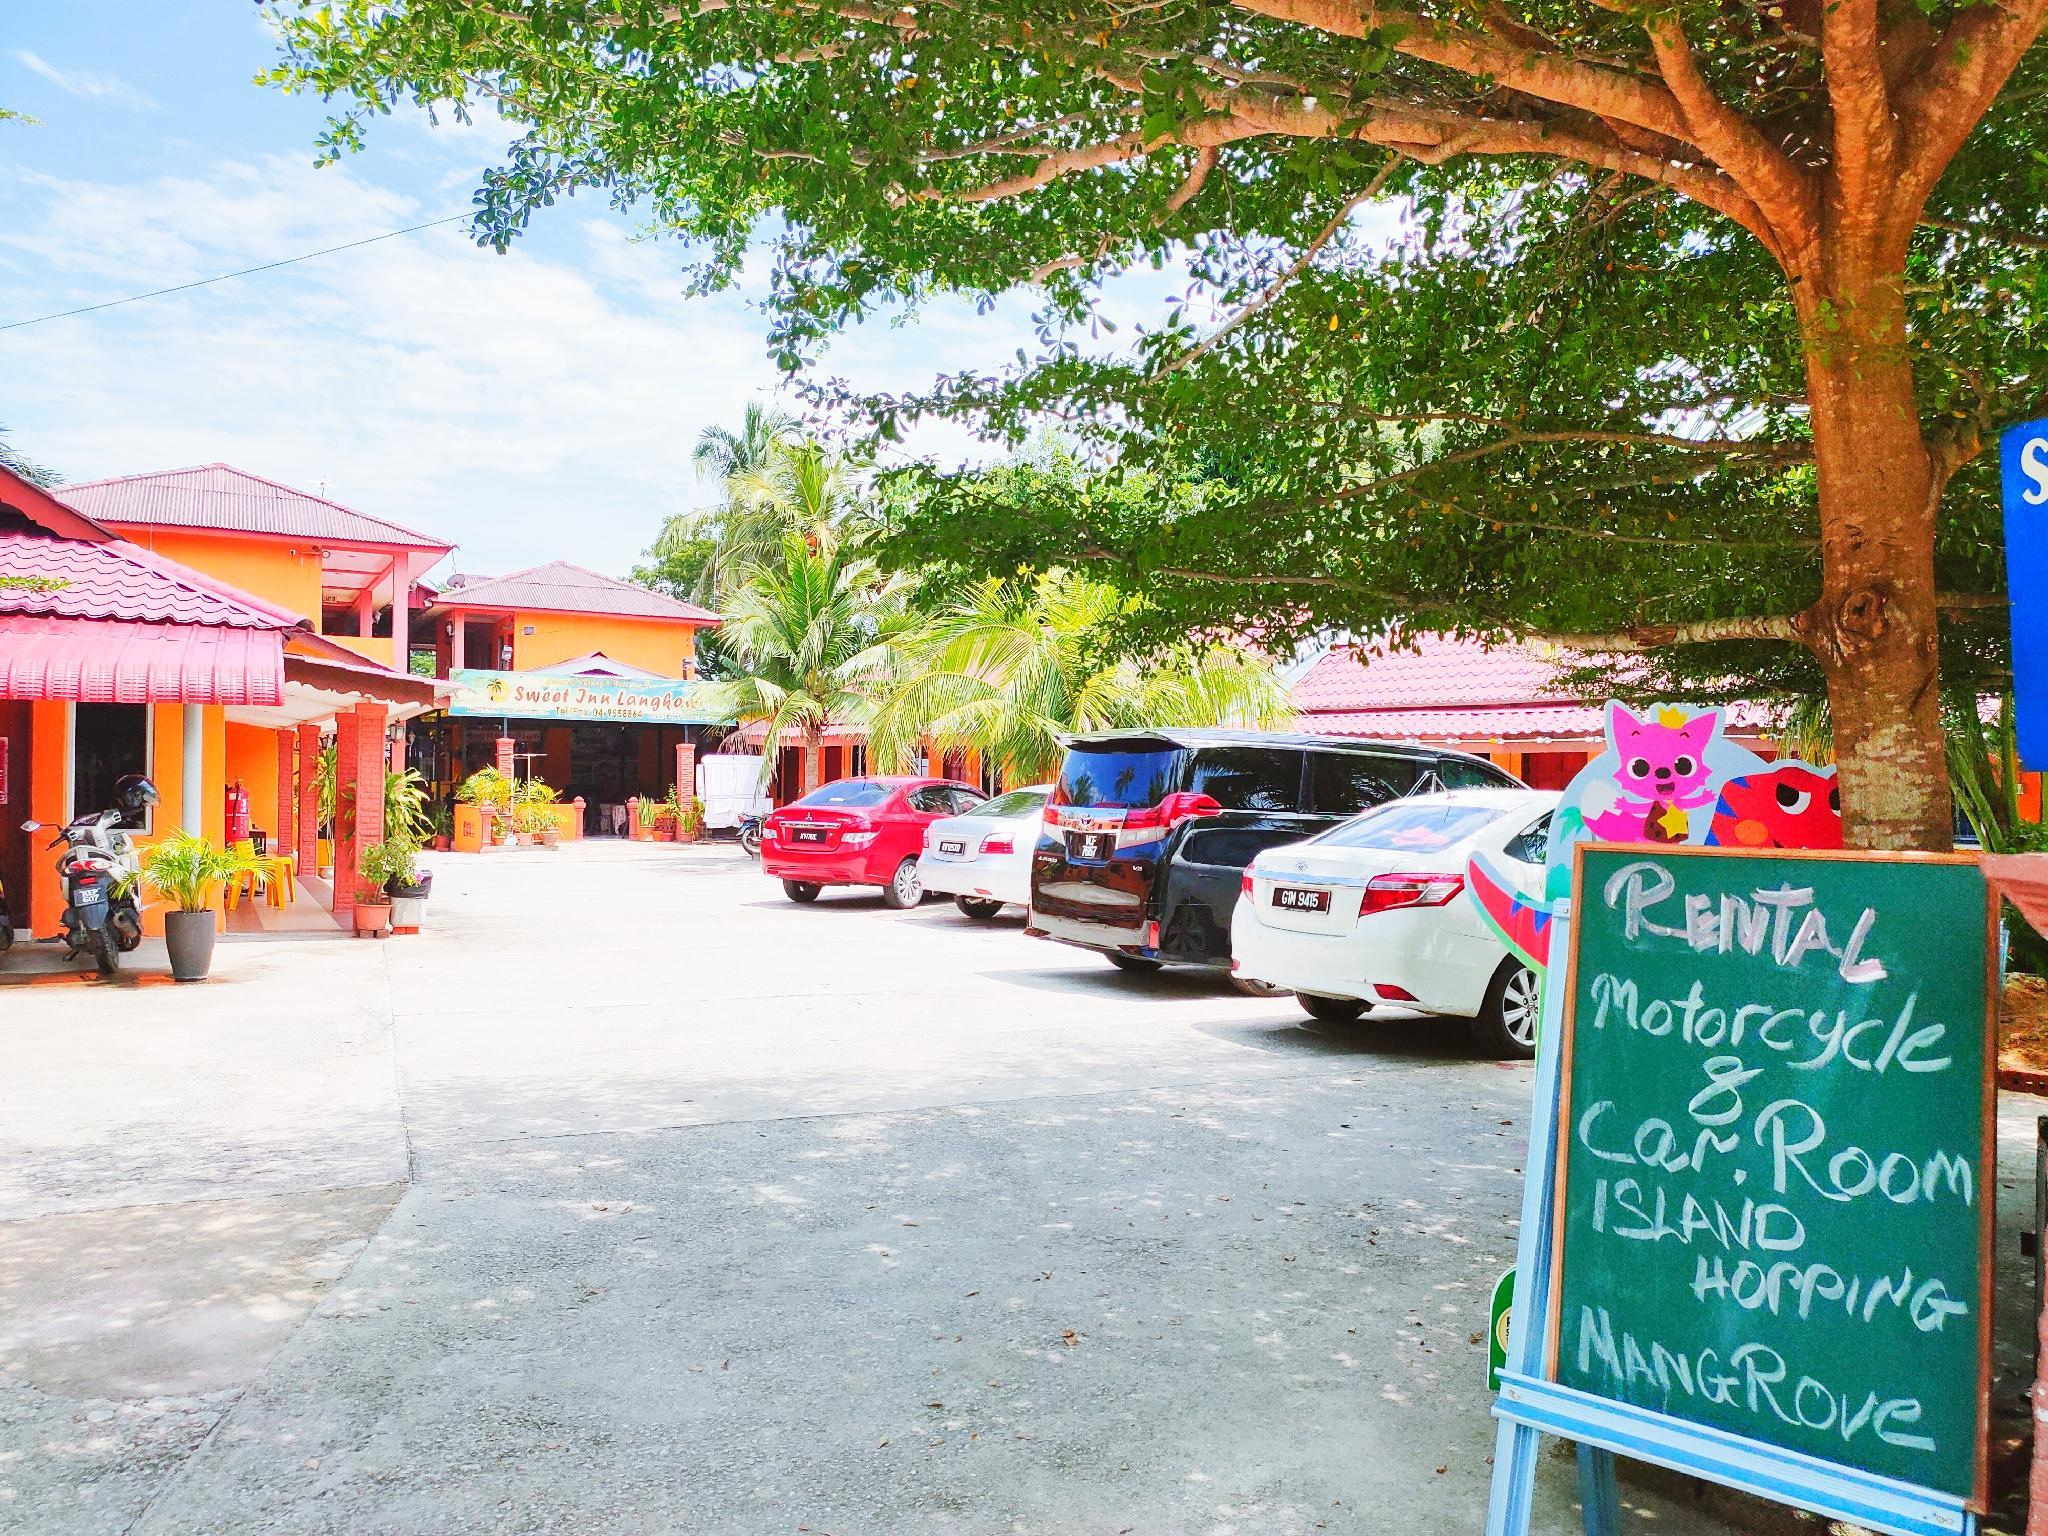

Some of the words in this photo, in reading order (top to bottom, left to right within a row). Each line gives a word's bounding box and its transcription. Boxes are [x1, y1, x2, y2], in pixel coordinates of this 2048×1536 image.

[515, 686, 569, 702] Sweet
[576, 688, 610, 705] Inn
[1298, 892, 1319, 908] 9415
[1603, 861, 1888, 984] RENTAL
[1590, 972, 1952, 1075] Motorcycle
[1592, 1177, 1806, 1252] ISLAND
[1689, 1254, 1969, 1333] HOPPING
